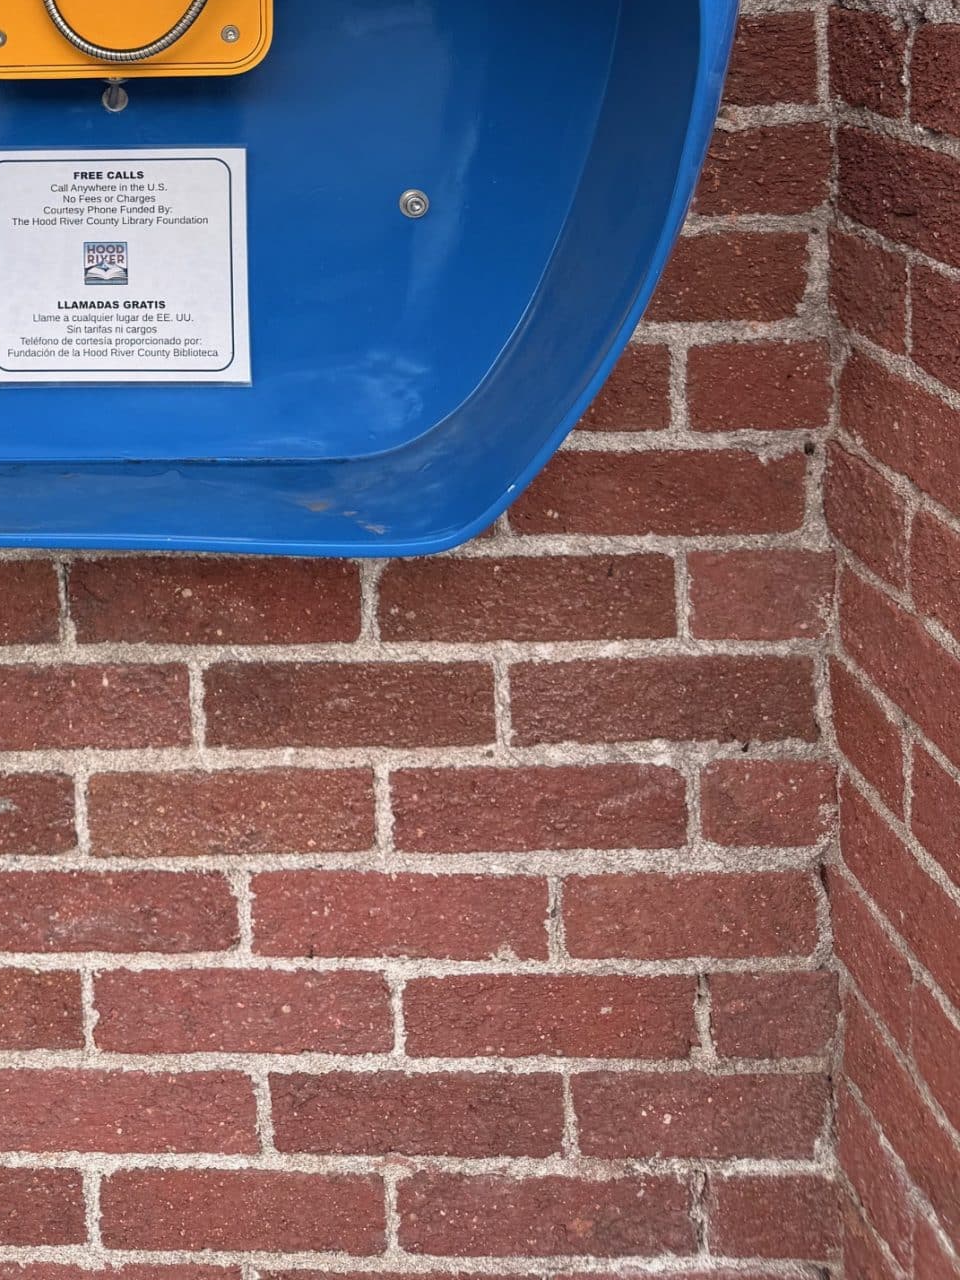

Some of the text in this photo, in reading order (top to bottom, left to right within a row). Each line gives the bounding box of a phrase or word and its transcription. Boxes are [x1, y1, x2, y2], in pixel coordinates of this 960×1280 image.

[107, 171, 144, 179] CALLS
[51, 184, 68, 192] Call
[70, 184, 116, 193] Anywhere
[147, 183, 167, 191] U.S.
[79, 195, 102, 203] Fees
[117, 195, 155, 203] Charges
[43, 206, 173, 215] Courtesy Phone Funded By:
[86, 217, 119, 226] County
[122, 217, 153, 226] Library
[87, 245, 125, 254] HOOD
[88, 255, 125, 264] RIVER
[58, 301, 165, 309] LLAMADAS GRATIS
[33, 314, 60, 322] Llame
[72, 314, 113, 323] cualquier
[116, 314, 139, 323] lugar
[126, 327, 157, 335] cargos
[20, 337, 59, 345] Teléfono
[61, 337, 72, 345] de
[115, 337, 181, 346] proporcionado
[184, 338, 202, 346] por:
[8, 349, 55, 357] Fundación
[58, 349, 69, 357] de
[72, 349, 80, 357] la
[83, 349, 107, 357] Hood
[137, 349, 170, 358] County
[173, 349, 218, 357] Biblioteca
